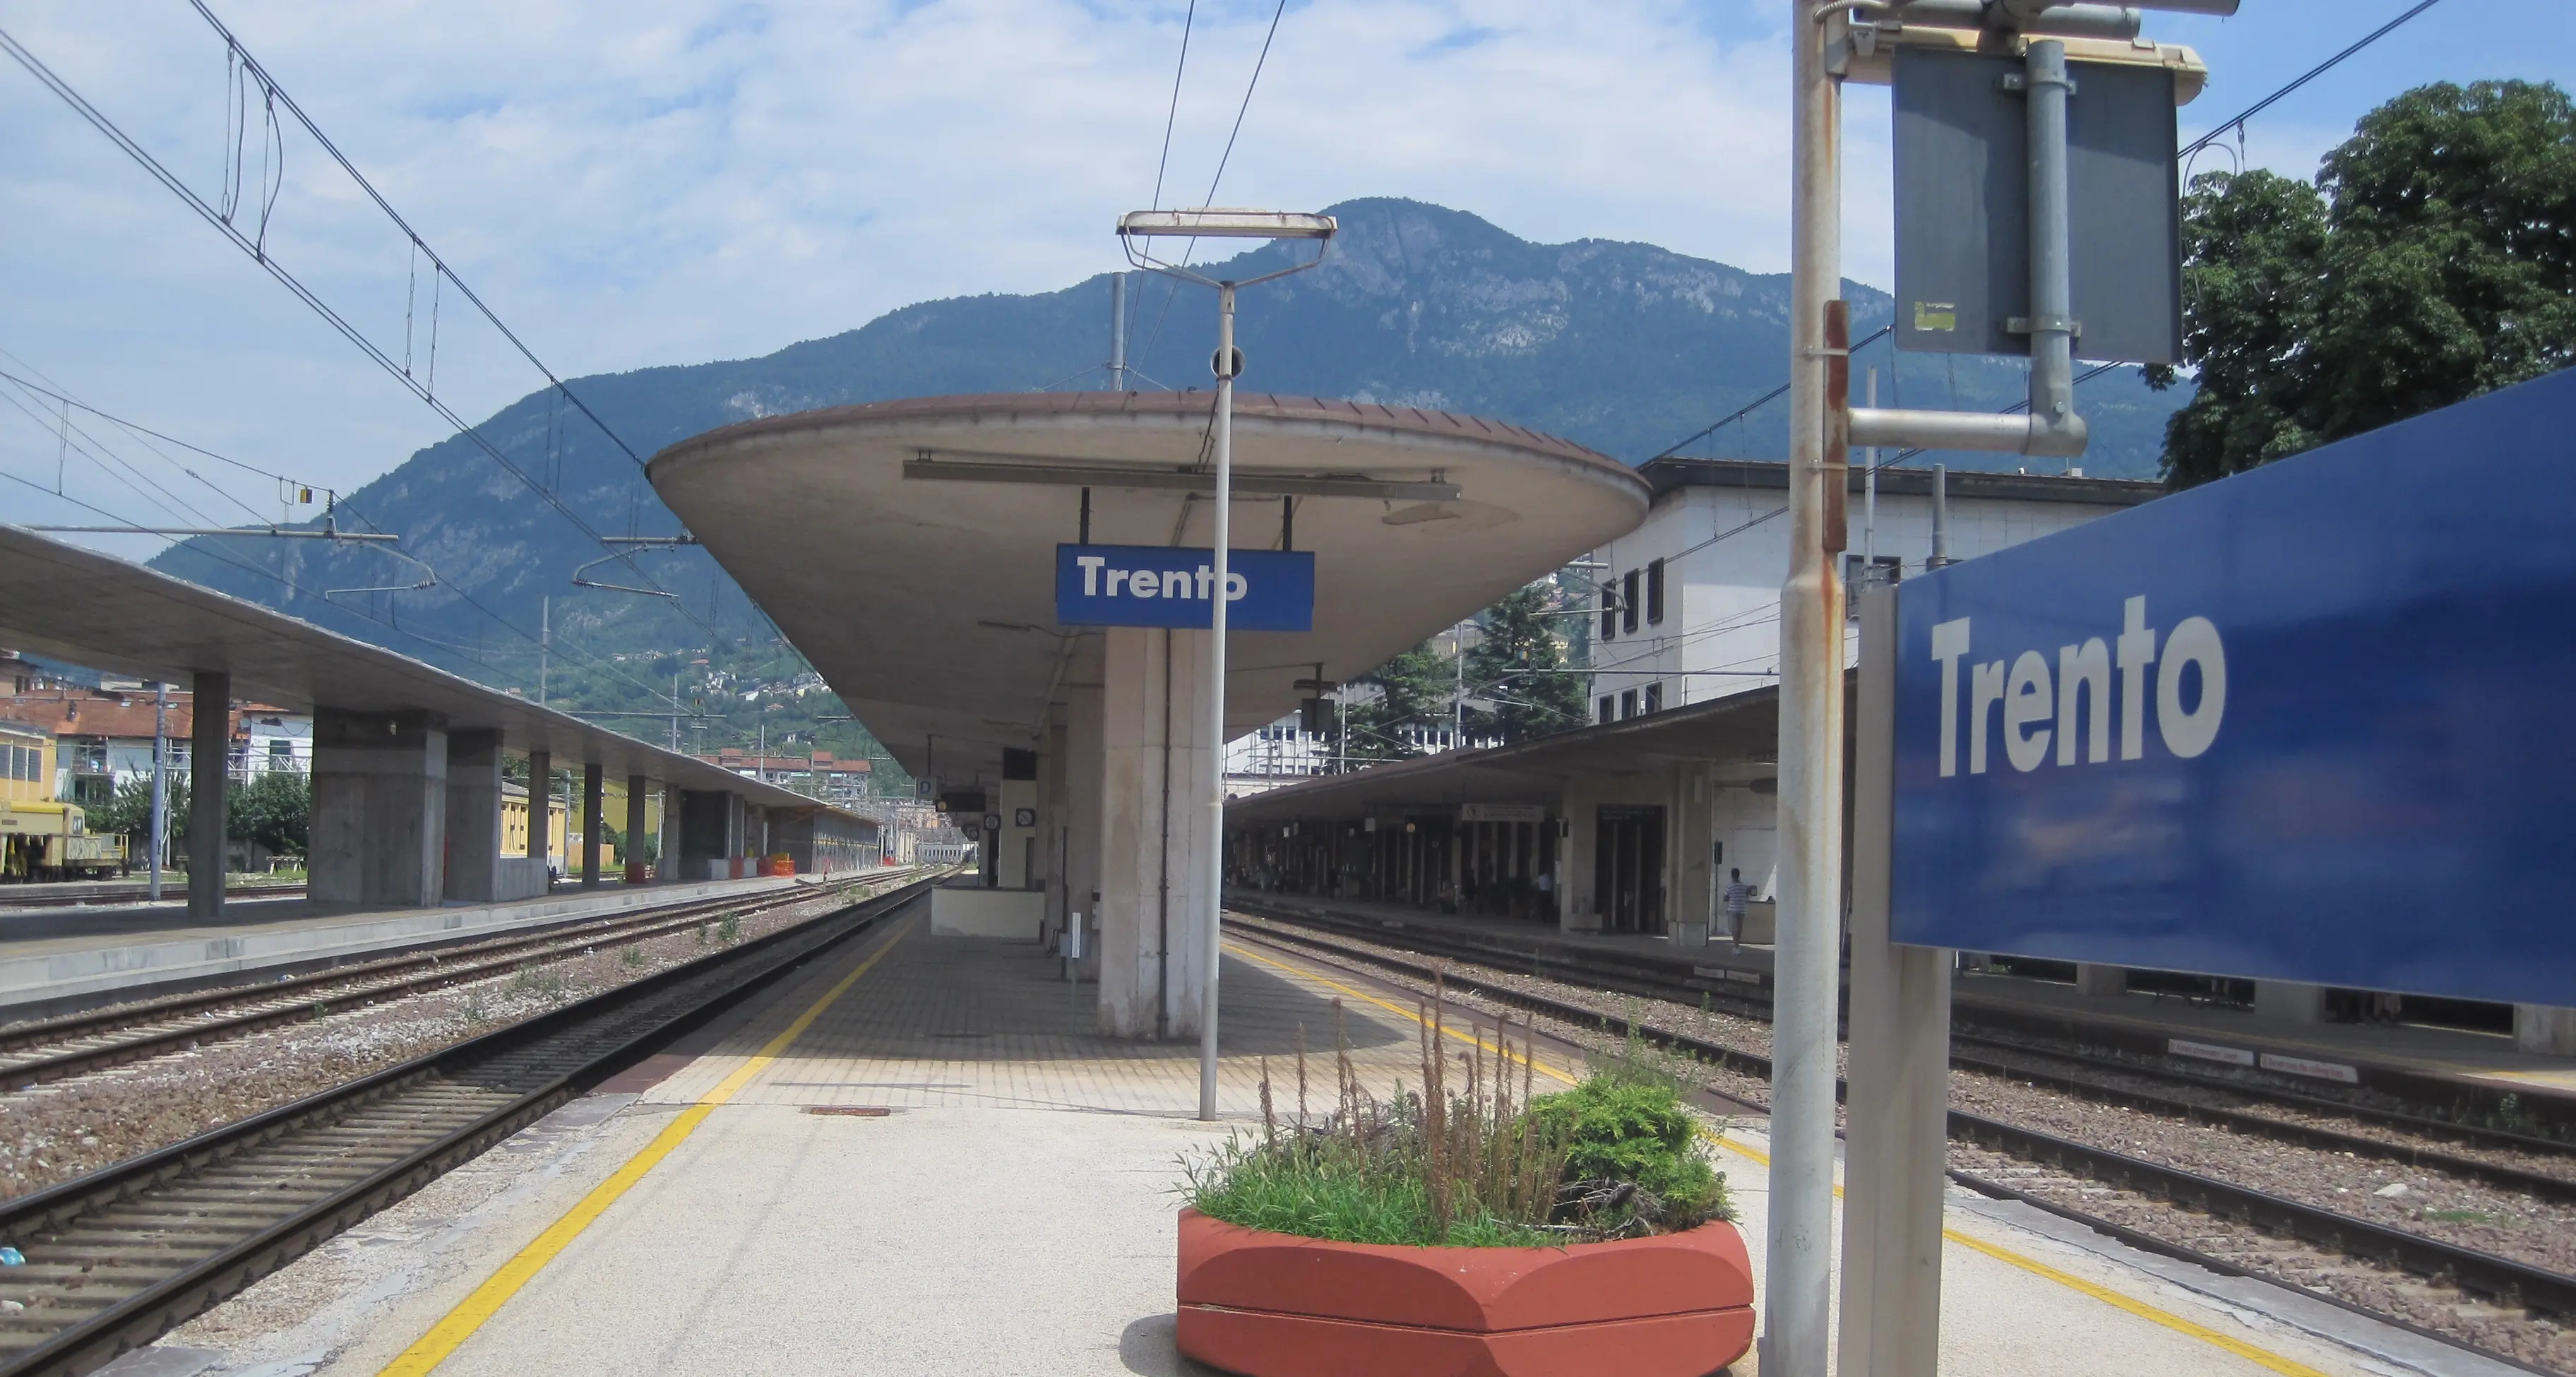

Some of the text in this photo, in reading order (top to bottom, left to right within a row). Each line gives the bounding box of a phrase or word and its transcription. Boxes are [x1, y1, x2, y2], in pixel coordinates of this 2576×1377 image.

[1077, 556, 1248, 601] Trento
[1931, 595, 2226, 777] Trento
[919, 780, 931, 794] D
